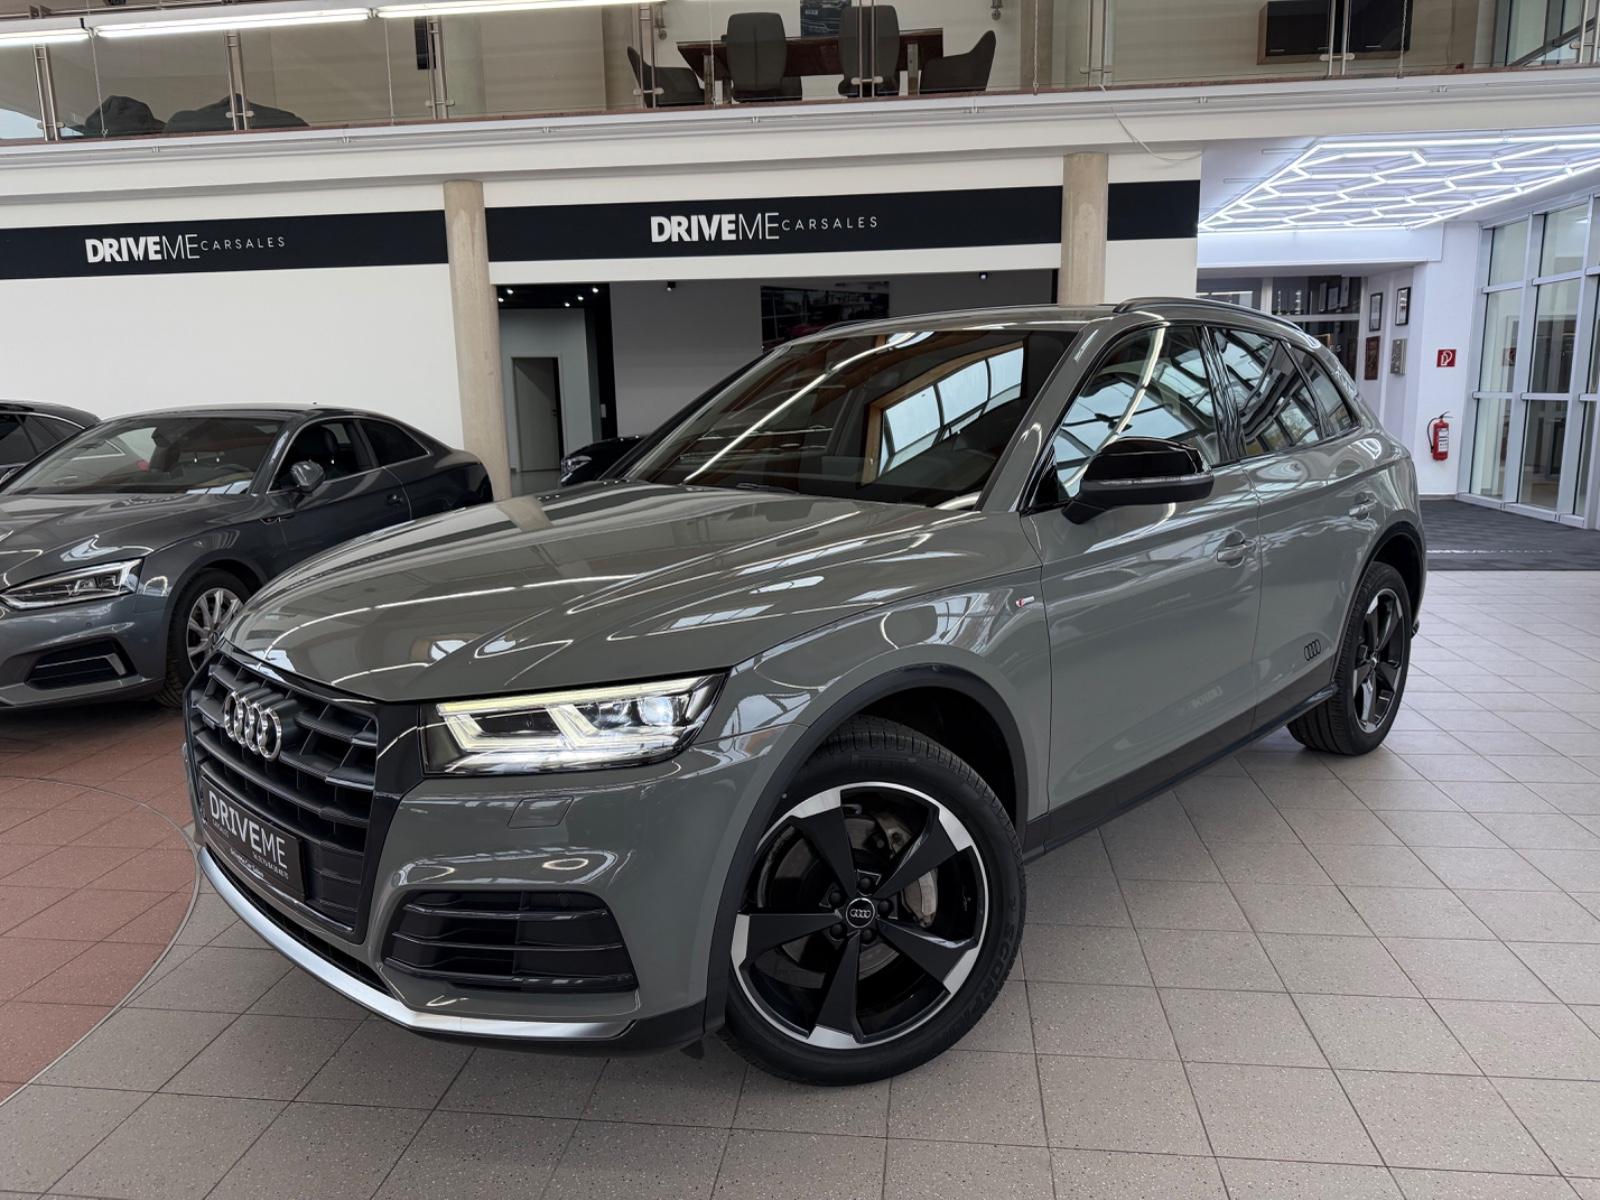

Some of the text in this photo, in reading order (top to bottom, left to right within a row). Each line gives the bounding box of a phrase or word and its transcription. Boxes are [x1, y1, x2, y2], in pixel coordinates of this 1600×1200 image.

[650, 212, 878, 242] DRIVEME CARSALES
[85, 233, 286, 263] DRIVEME CARSALES
[209, 790, 288, 869] DRIVEME
